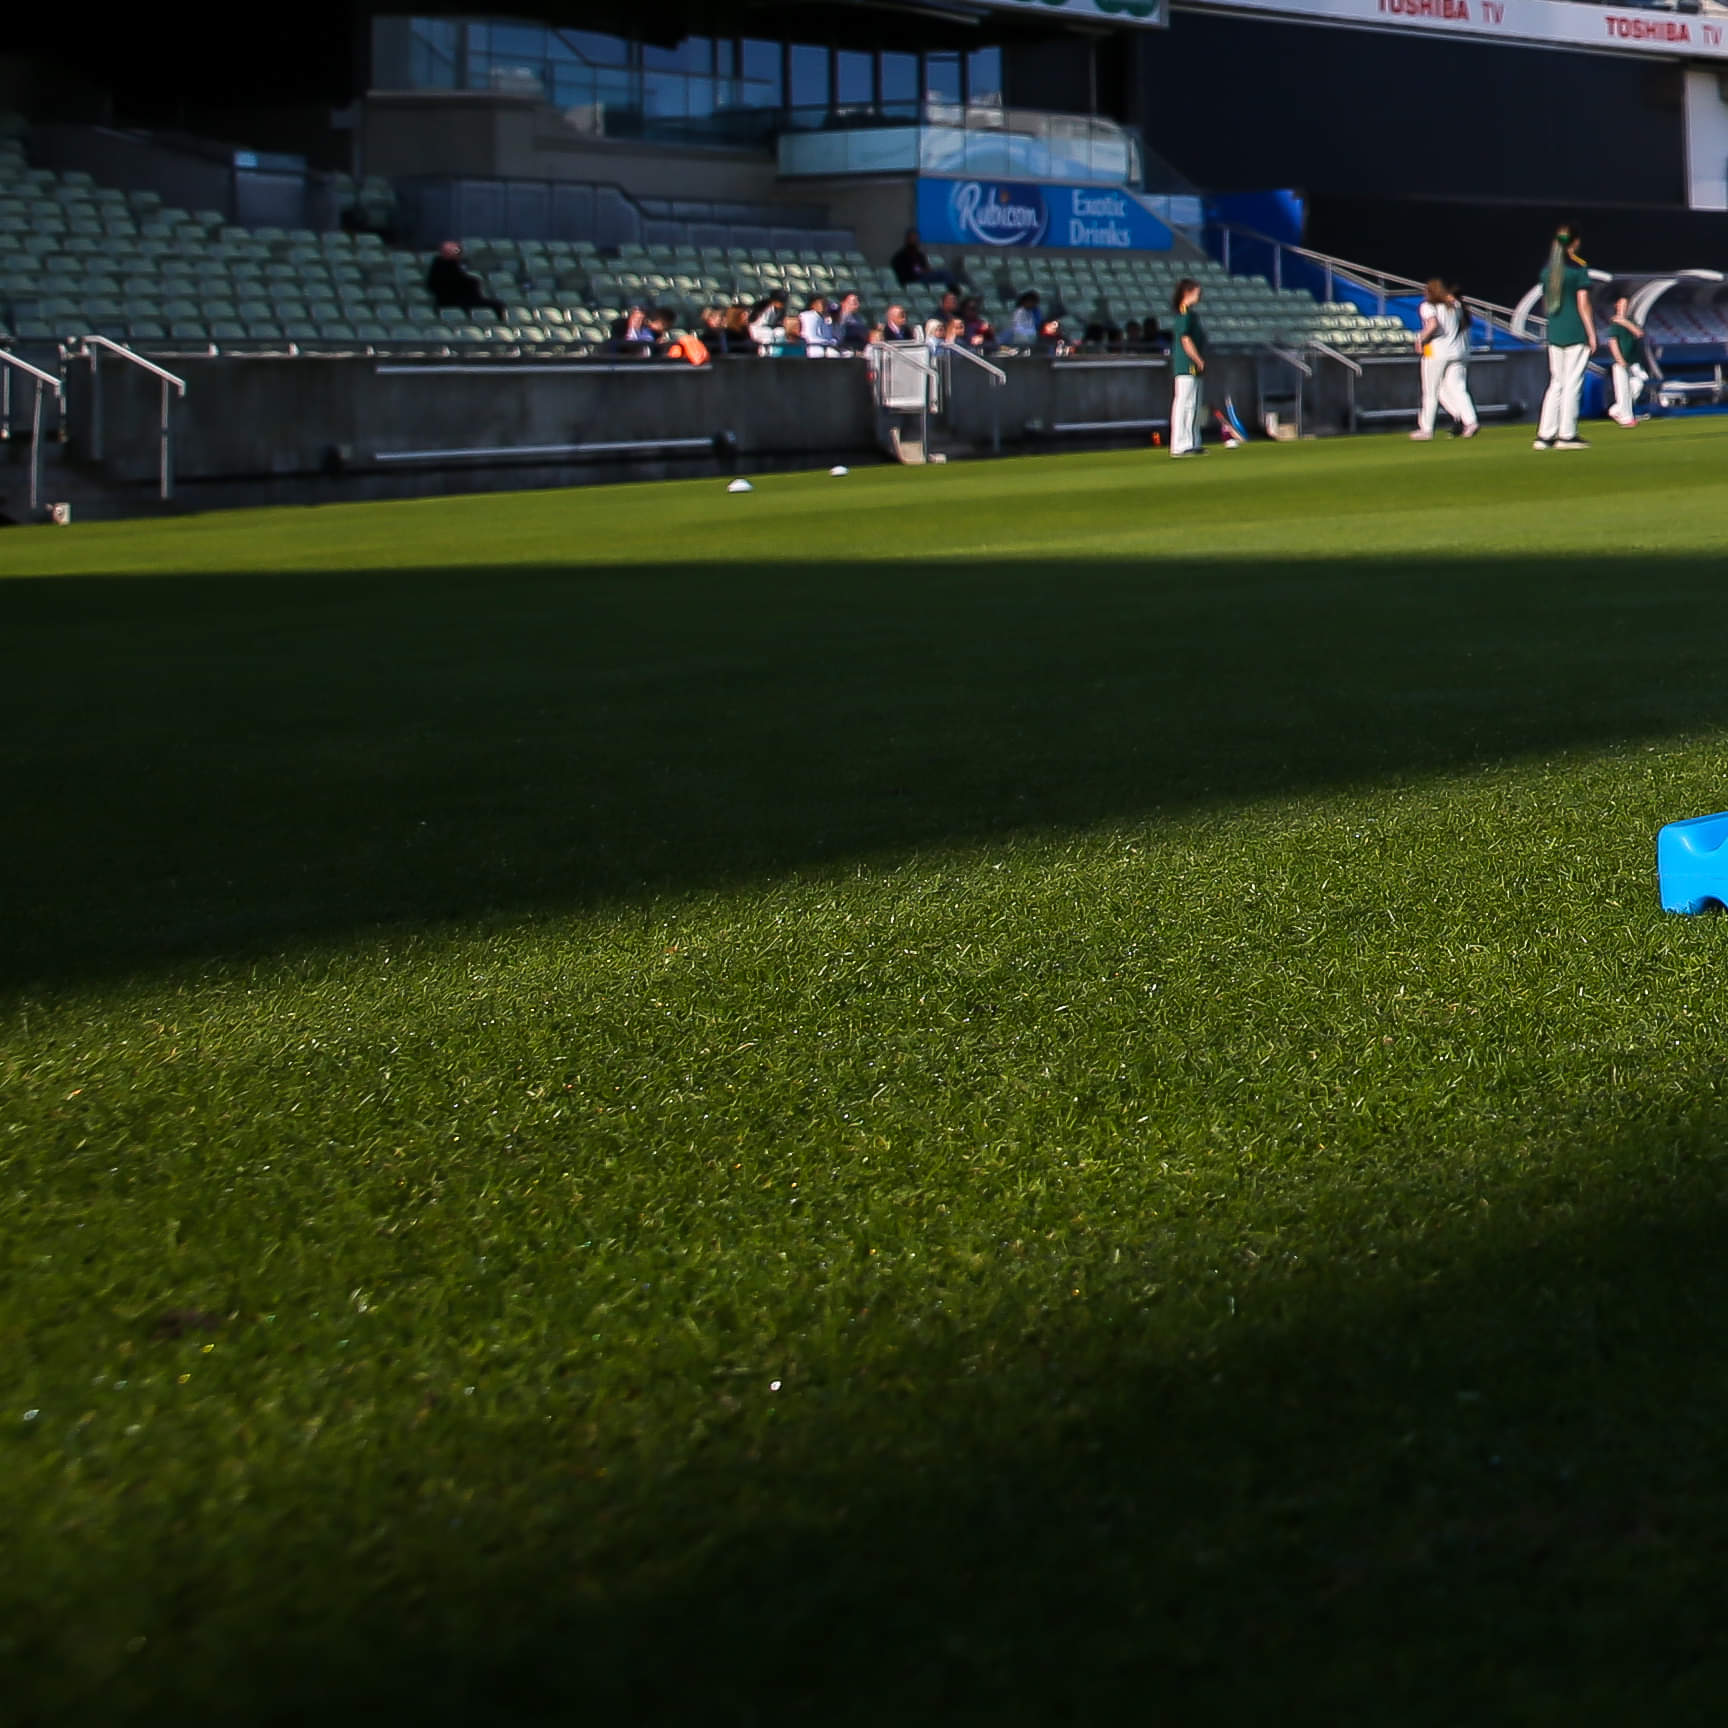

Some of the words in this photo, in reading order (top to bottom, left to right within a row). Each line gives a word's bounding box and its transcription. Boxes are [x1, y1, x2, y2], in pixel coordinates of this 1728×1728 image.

[1482, 3, 1504, 26] TV
[1606, 15, 1689, 44] TOSHIBA
[1703, 25, 1722, 47] TV
[957, 182, 1040, 236] Rubicon
[1072, 189, 1126, 216] Exotic
[1069, 219, 1131, 247] Drinks
